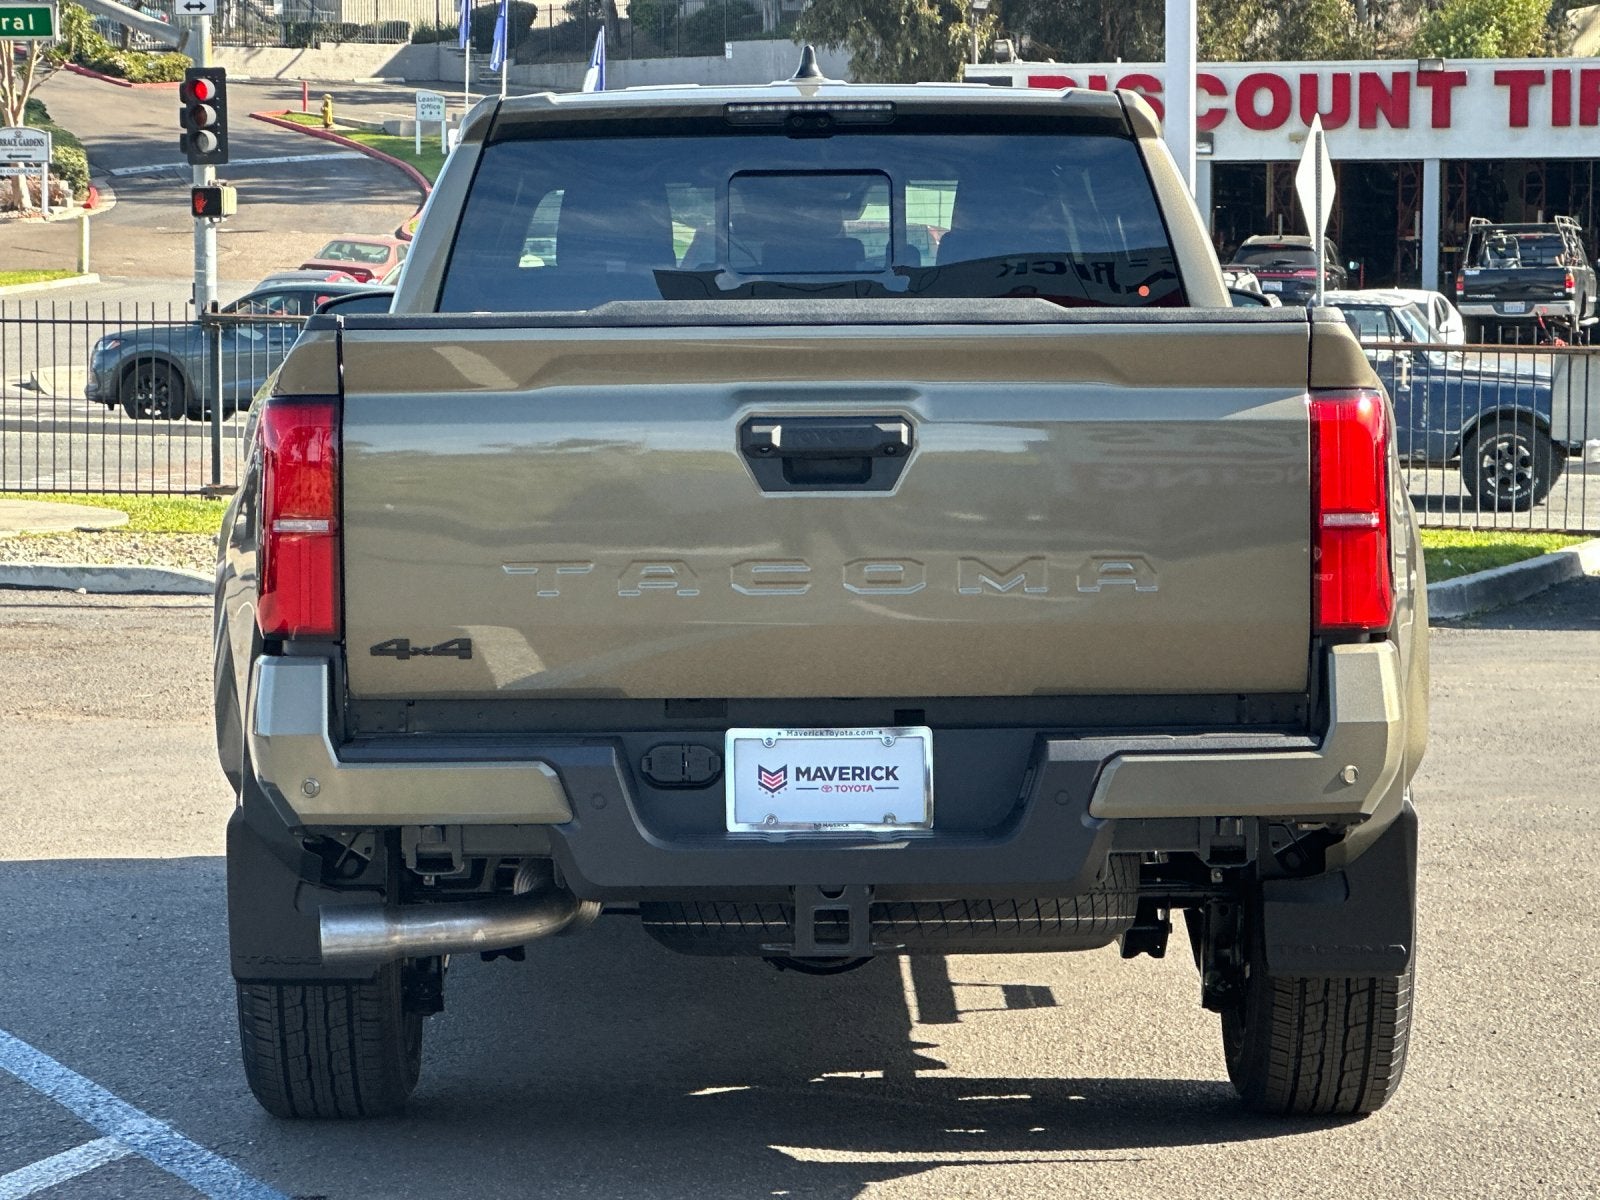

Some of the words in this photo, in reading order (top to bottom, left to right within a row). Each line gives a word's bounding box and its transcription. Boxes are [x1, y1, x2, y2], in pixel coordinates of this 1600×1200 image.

[1, 13, 35, 31] ral
[18, 138, 44, 146] GARDENS
[502, 556, 1159, 597] TACOMA
[369, 638, 473, 660] 4x4
[786, 729, 874, 737] MaverickToyota.com
[795, 766, 899, 782] MAVERICK
[834, 784, 874, 793] TOYOTA
